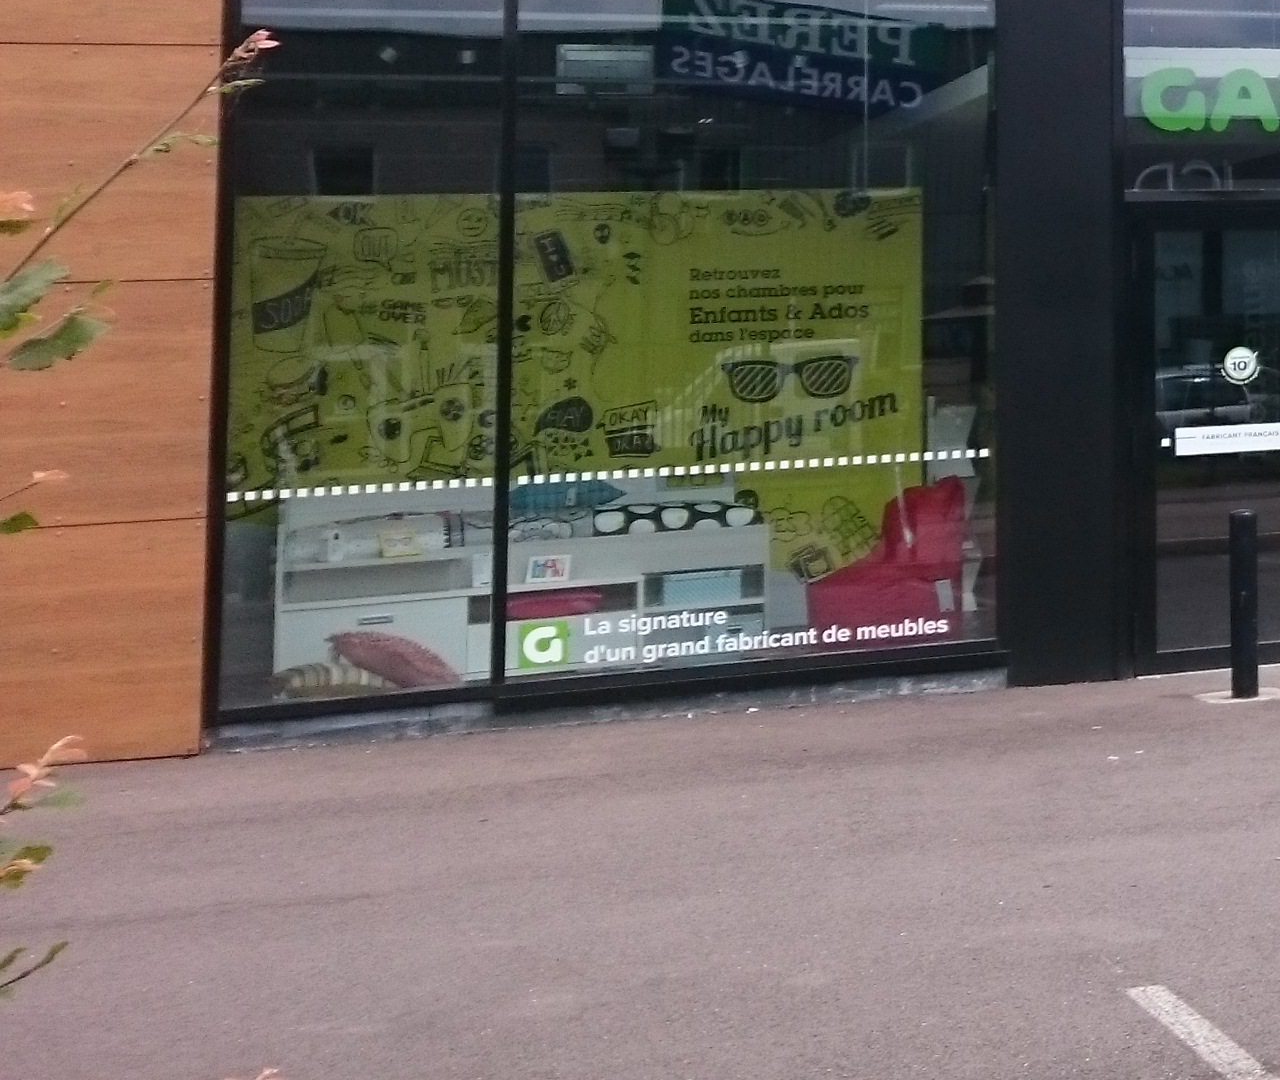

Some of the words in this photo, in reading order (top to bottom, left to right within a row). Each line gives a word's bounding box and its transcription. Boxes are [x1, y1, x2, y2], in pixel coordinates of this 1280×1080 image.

[688, 269, 782, 282] Retrouvez
[688, 288, 721, 301] nos
[725, 284, 818, 299] chambres
[822, 283, 866, 299] pour
[689, 306, 778, 325] Enfants
[786, 304, 802, 321] &
[808, 303, 870, 320] Ados
[689, 329, 734, 343] dans
[739, 326, 816, 343] l'espace
[689, 414, 803, 461] Happy
[813, 392, 899, 433] room
[701, 403, 730, 427] My
[584, 618, 612, 636] La
[618, 610, 728, 635] signature
[584, 642, 637, 664] d'un
[642, 636, 710, 663] grand
[715, 628, 817, 653] fabricant
[822, 624, 851, 643] de
[857, 616, 949, 642] meubles
